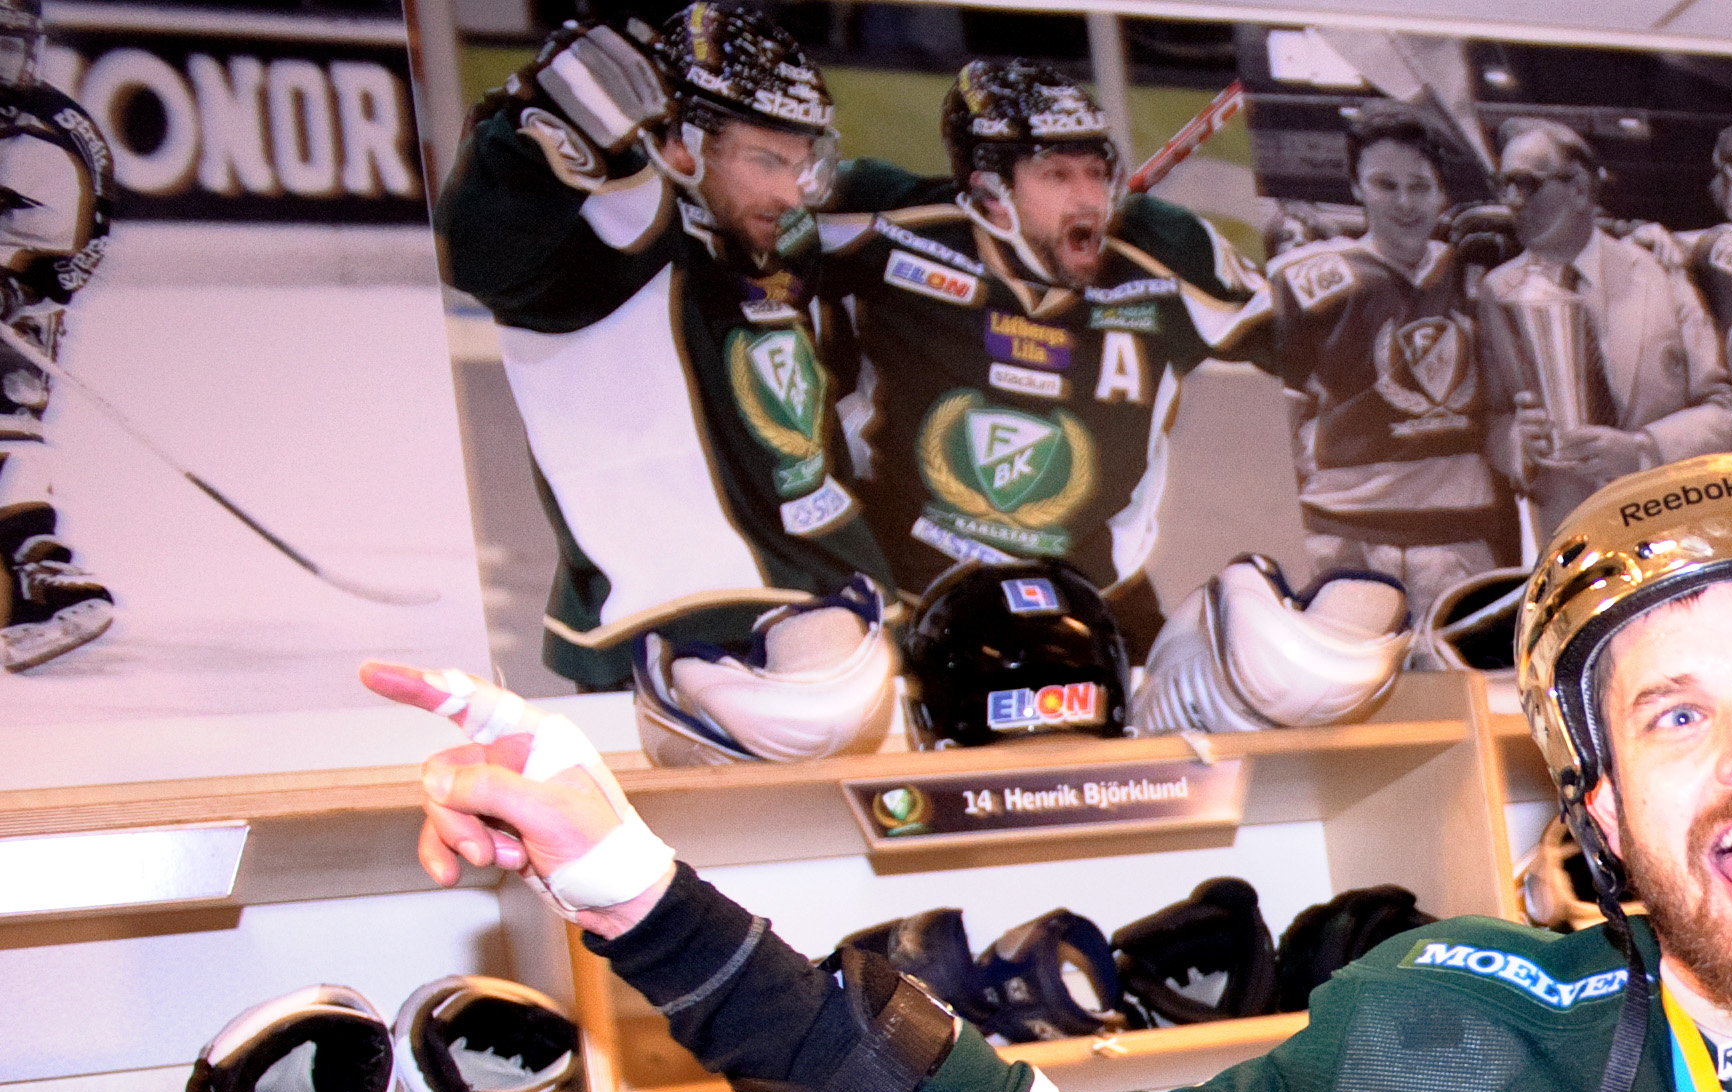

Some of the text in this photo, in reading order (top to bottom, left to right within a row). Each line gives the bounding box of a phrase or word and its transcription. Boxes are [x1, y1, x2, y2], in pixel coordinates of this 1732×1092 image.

[892, 259, 972, 299] ELON
[1095, 331, 1141, 400] A
[989, 682, 1097, 728] ELON
[963, 777, 1188, 814] 14 Henrik Björklund
